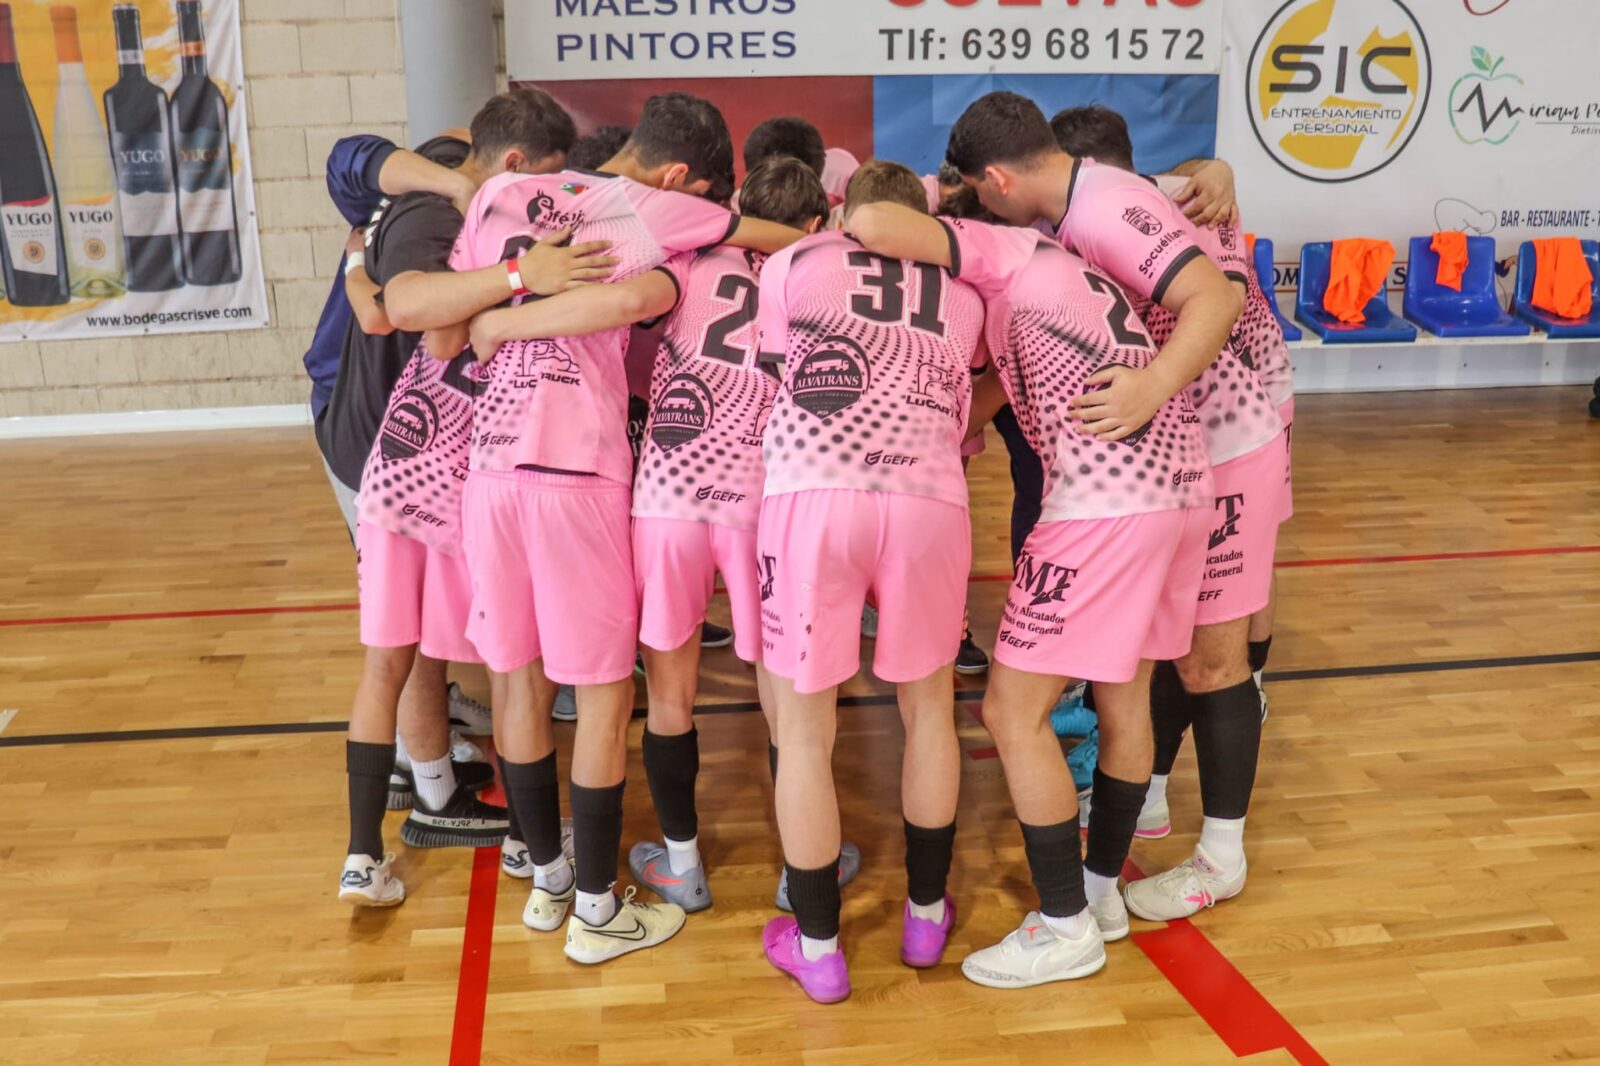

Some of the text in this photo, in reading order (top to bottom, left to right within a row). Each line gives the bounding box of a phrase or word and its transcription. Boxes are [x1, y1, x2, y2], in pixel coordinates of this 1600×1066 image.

[556, 31, 798, 62] PINTORES
[878, 28, 1206, 61] Tlf: 639 68 15 72
[1269, 44, 1412, 94] SIC
[1271, 107, 1402, 120] ENTRENAMIENTO
[1293, 123, 1379, 135] PERSONAL
[120, 149, 165, 164] YUGO
[6, 212, 52, 226] YUGO
[68, 210, 113, 224] YUGO
[1500, 209, 1520, 227] BAR
[1526, 209, 1590, 227] RESTAURANTE
[843, 250, 949, 342] 31
[86, 306, 252, 327] www.bodegascrisve.com
[698, 270, 760, 370] 2
[795, 374, 860, 390] ALVATRANS
[490, 435, 519, 445] GEFF
[882, 454, 919, 467] GEFF
[1182, 471, 1203, 483] GEFF
[711, 490, 746, 503] GEFF
[415, 510, 447, 527] GEFF
[1208, 562, 1243, 579] General
[1197, 589, 1223, 602] EFF
[1020, 606, 1066, 624] Alicatados
[1016, 620, 1064, 635] en General
[1007, 637, 1037, 650] GEFF
